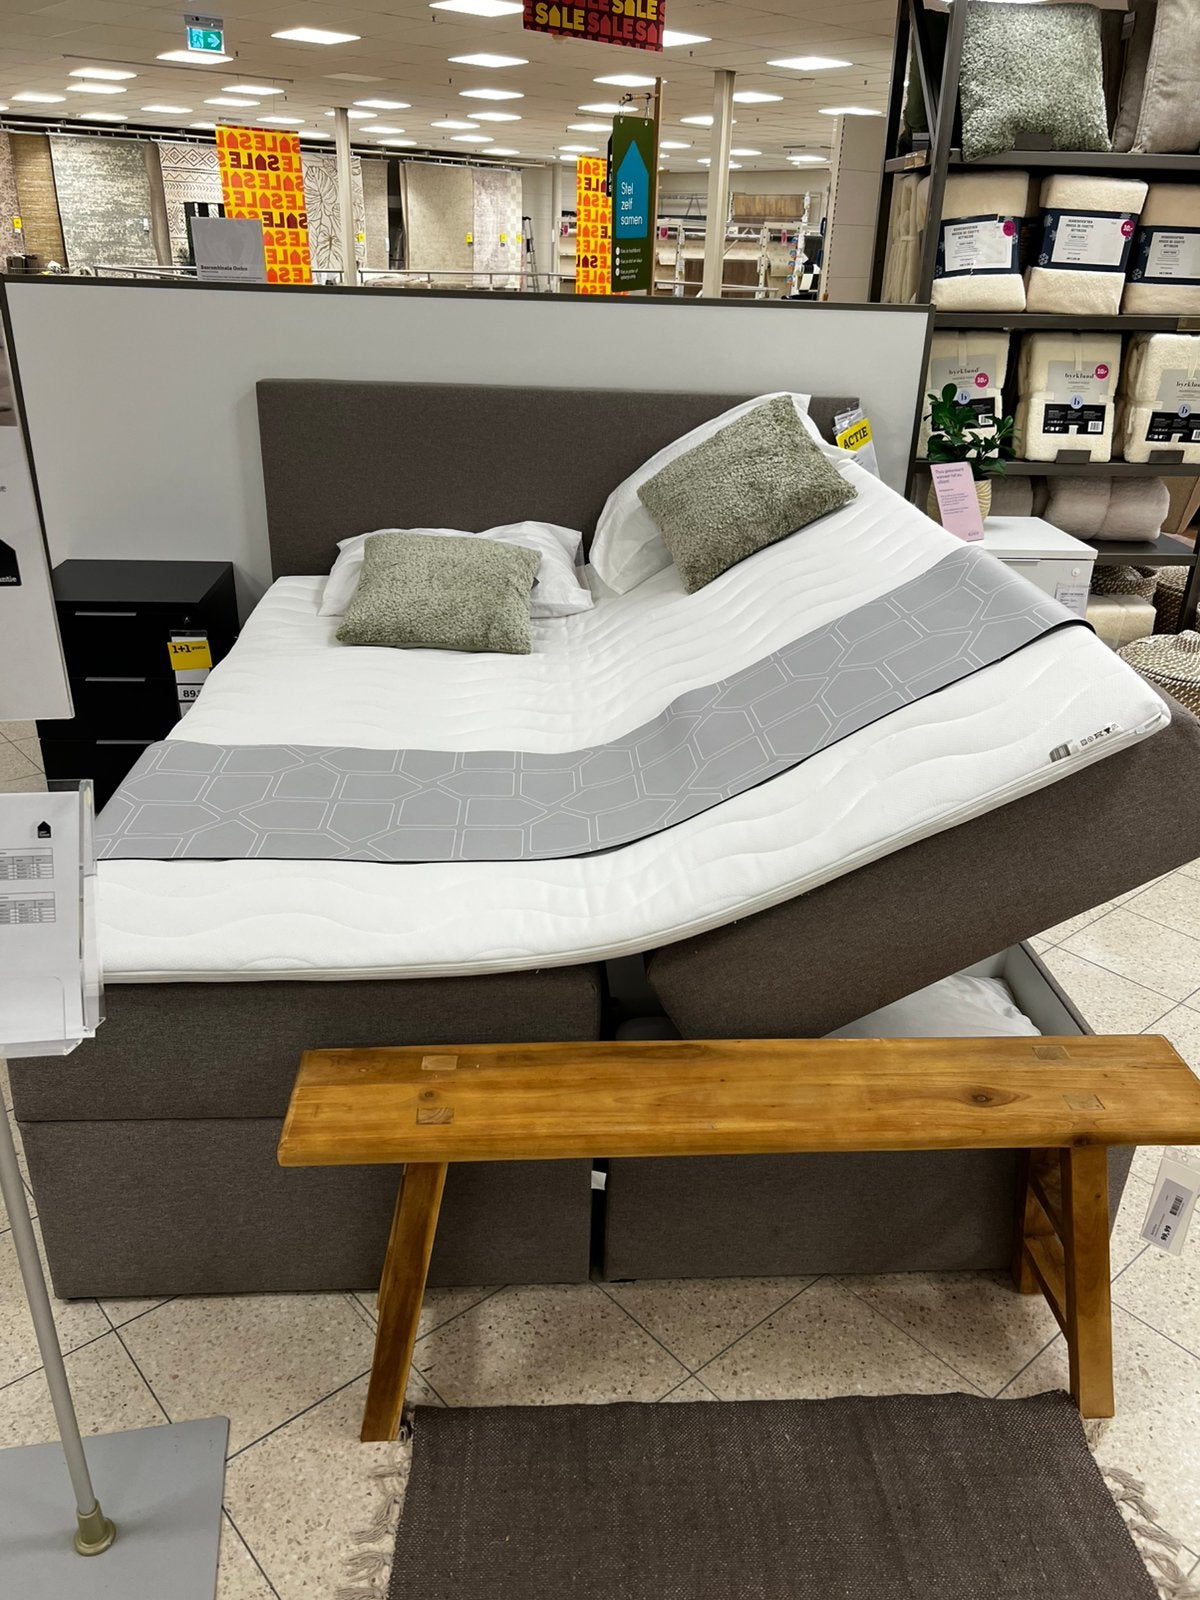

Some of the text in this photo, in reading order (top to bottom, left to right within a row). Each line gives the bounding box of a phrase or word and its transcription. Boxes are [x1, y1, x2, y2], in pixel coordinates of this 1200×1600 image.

[621, 182, 634, 196] Stel
[621, 199, 633, 211] zelf
[620, 215, 643, 226] samen
[843, 426, 868, 450] ACTIE
[172, 644, 191, 654] 1+1
